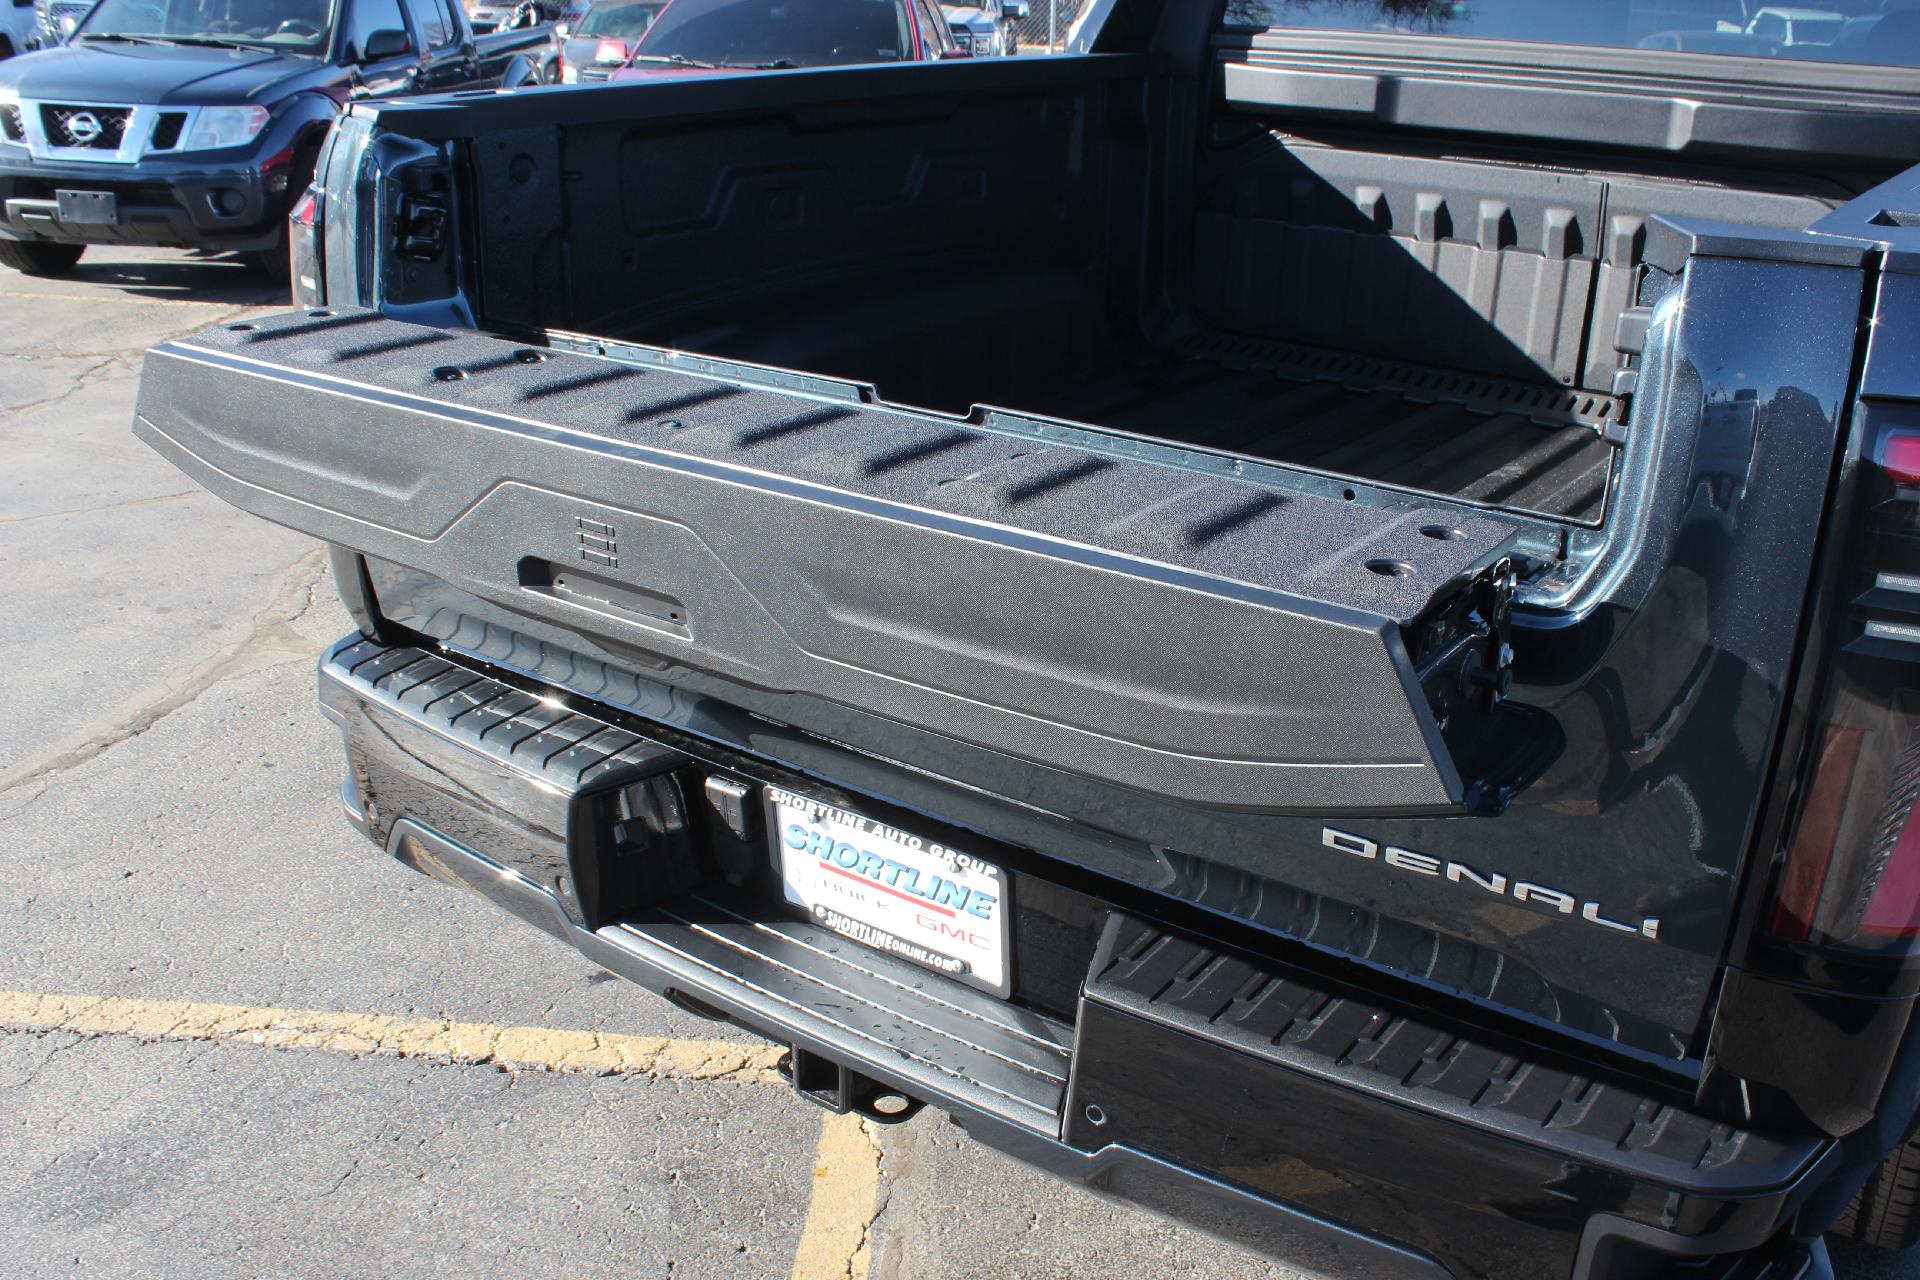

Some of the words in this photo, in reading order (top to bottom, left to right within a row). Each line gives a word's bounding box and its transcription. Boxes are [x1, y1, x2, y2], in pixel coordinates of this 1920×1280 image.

[769, 789, 867, 832] SHORTLINE
[870, 822, 922, 851] AUTO
[929, 844, 998, 877] GROUP
[784, 823, 998, 920] SHORTLINE
[1322, 826, 1661, 940] DENALI
[916, 913, 993, 951] GMC
